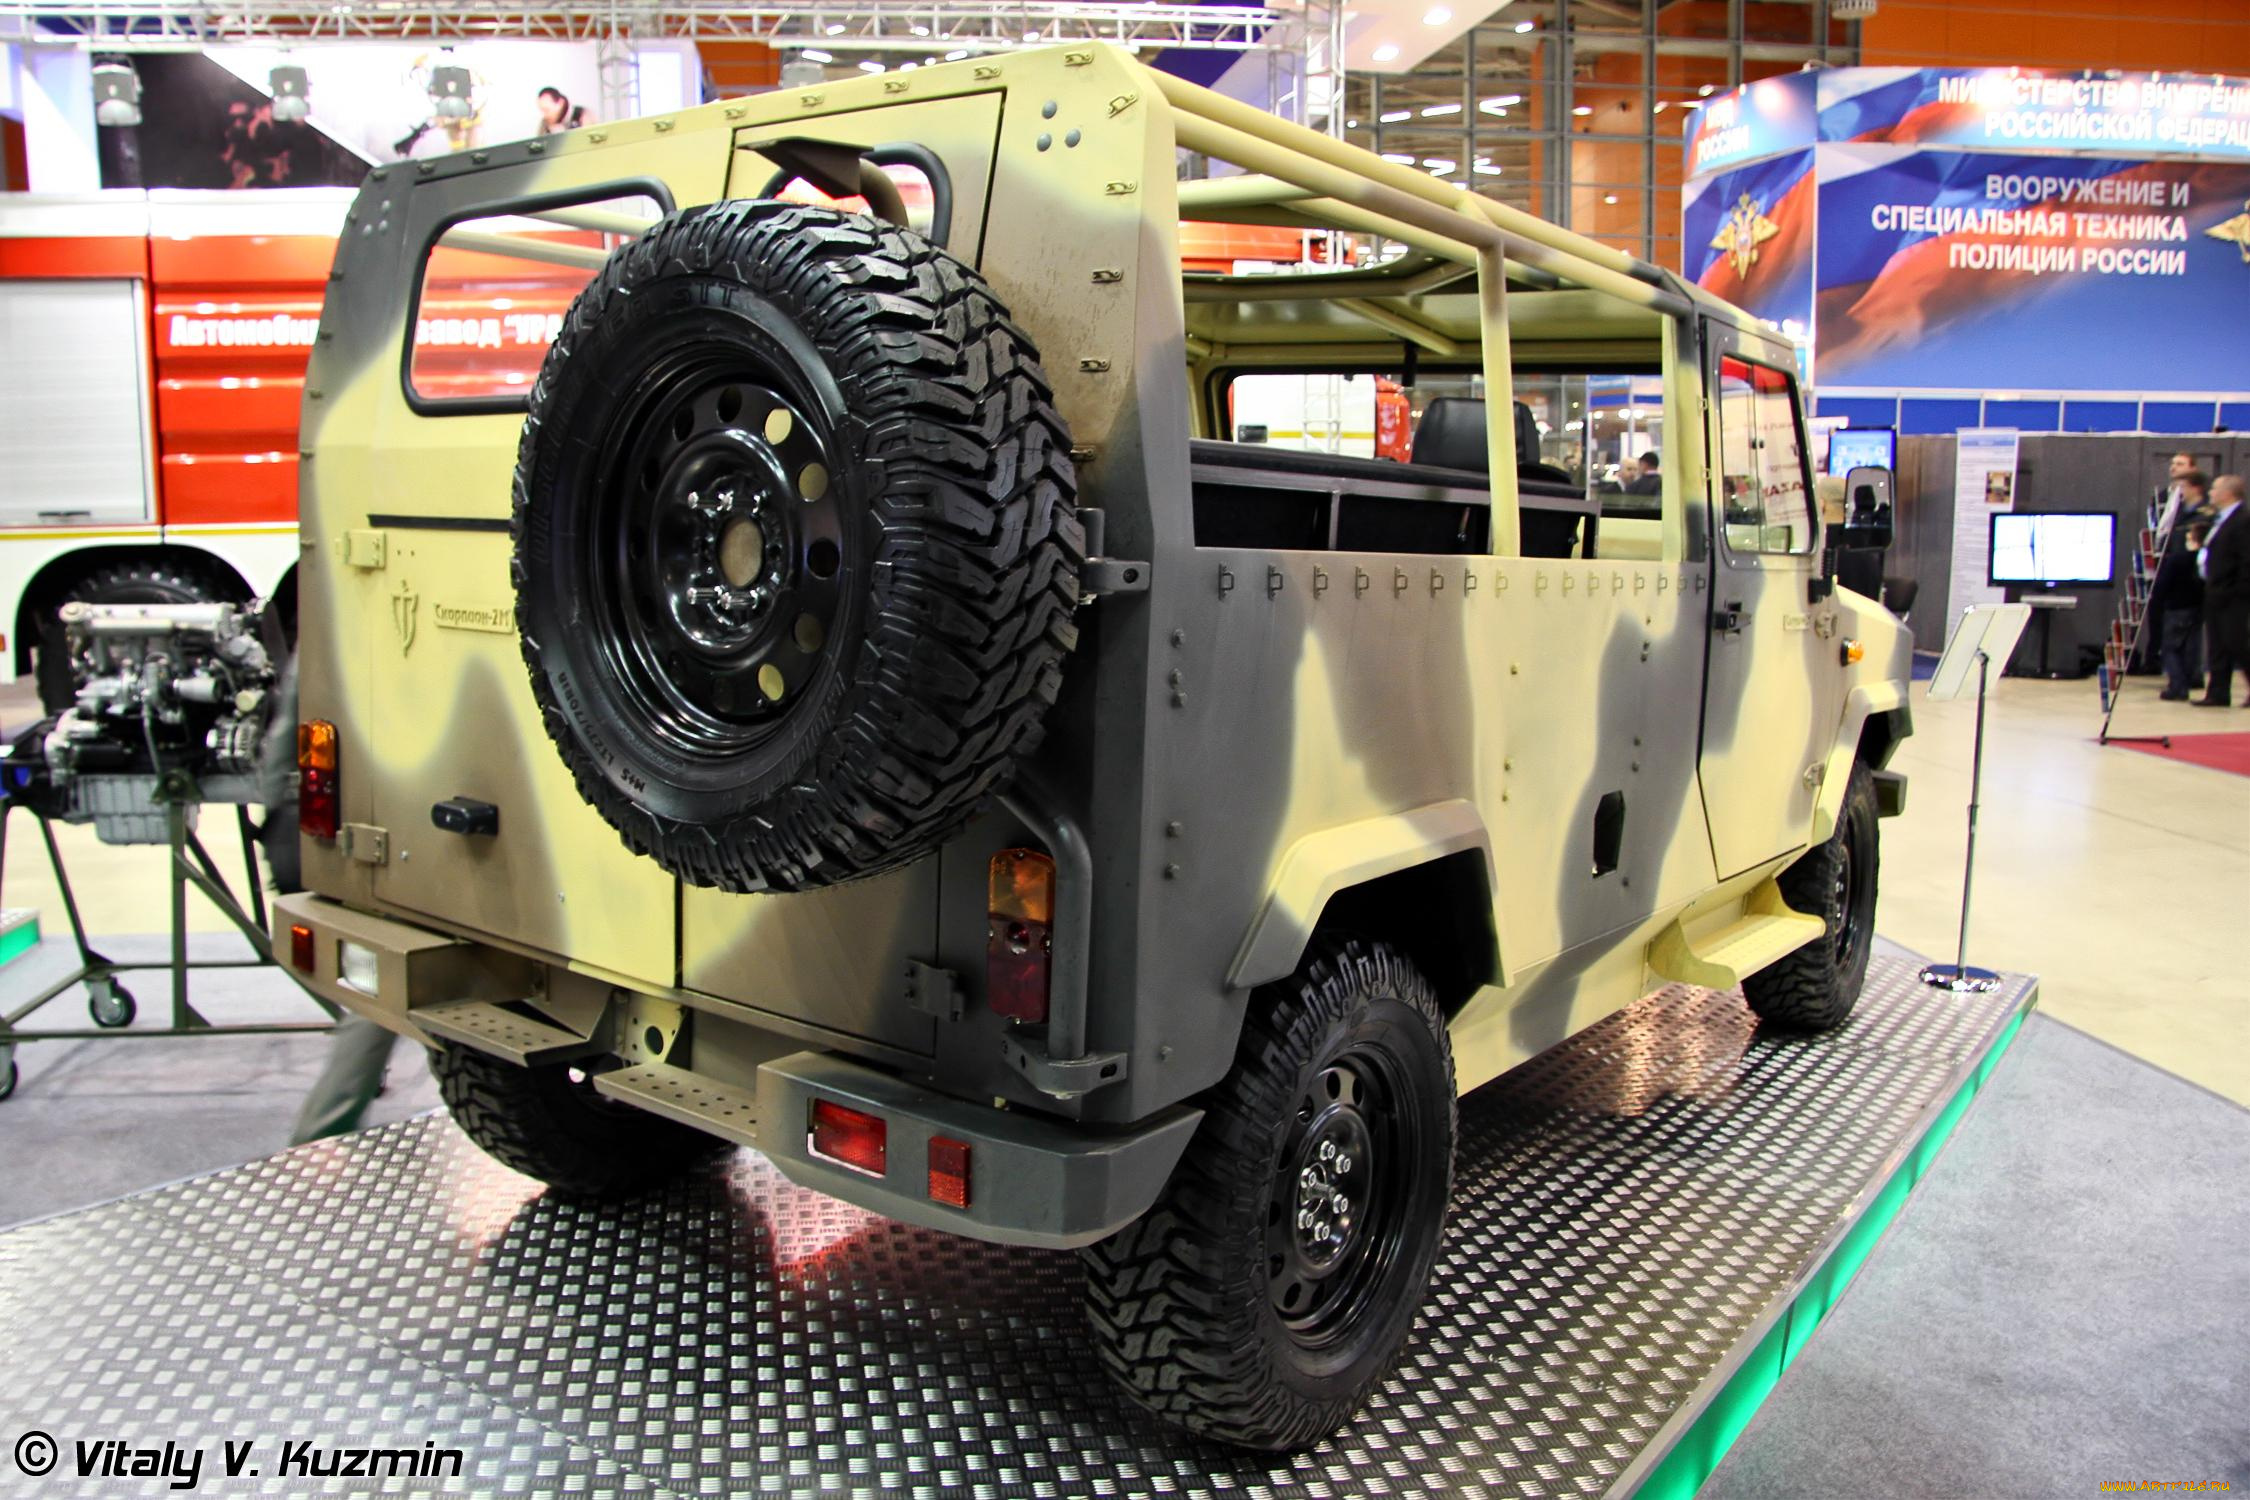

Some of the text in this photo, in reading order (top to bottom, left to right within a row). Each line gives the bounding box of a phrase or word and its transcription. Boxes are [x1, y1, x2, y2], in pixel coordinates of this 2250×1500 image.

[1939, 77, 2139, 108] МИСТЕРСТВО
[1984, 107, 2152, 140] РОССИЙСКОЙ
[1985, 174, 2190, 206] ВООРУЖЕНИЕ И
[1871, 203, 2188, 242] СПЕЦИАЛЬНАЯ ТЕХНИКА
[1949, 242, 2188, 276] ПОЛИЦИИ РОССИИ
